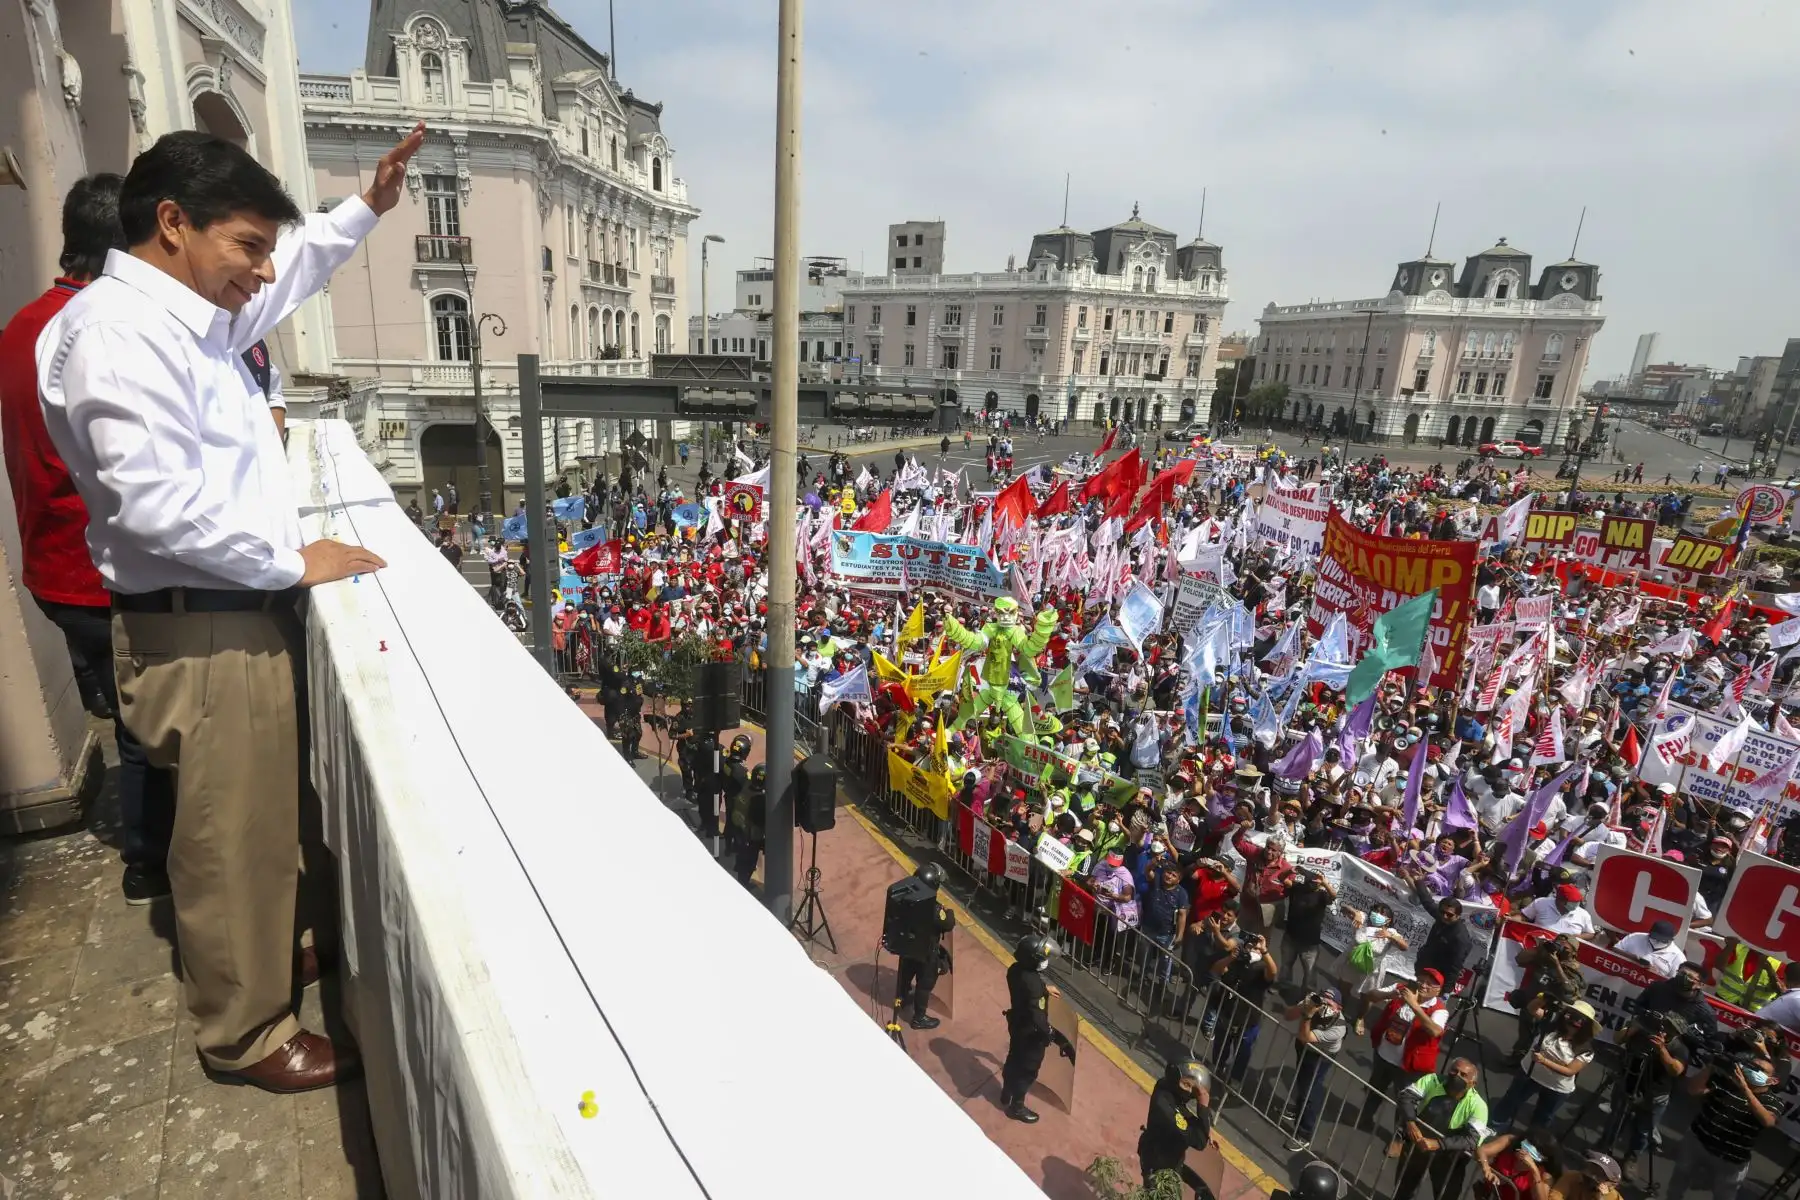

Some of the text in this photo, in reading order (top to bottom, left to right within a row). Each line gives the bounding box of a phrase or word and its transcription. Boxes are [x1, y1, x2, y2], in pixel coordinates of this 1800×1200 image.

[1290, 504, 1328, 523] DESPIDOS
[1526, 514, 1575, 540] DIP
[1605, 520, 1644, 549] NA
[951, 545, 977, 555] clasista
[1575, 535, 1598, 557] CO
[1666, 539, 1723, 570] DIP
[840, 561, 884, 571] ESTUDIANTES
[1381, 588, 1443, 620] MAO
[1759, 750, 1776, 762] DE
[1776, 743, 1793, 757] DE
[1745, 755, 1761, 767] DE
[1306, 856, 1331, 866] CCP
[1594, 854, 1690, 938] C
[1586, 984, 1619, 1006] EN
